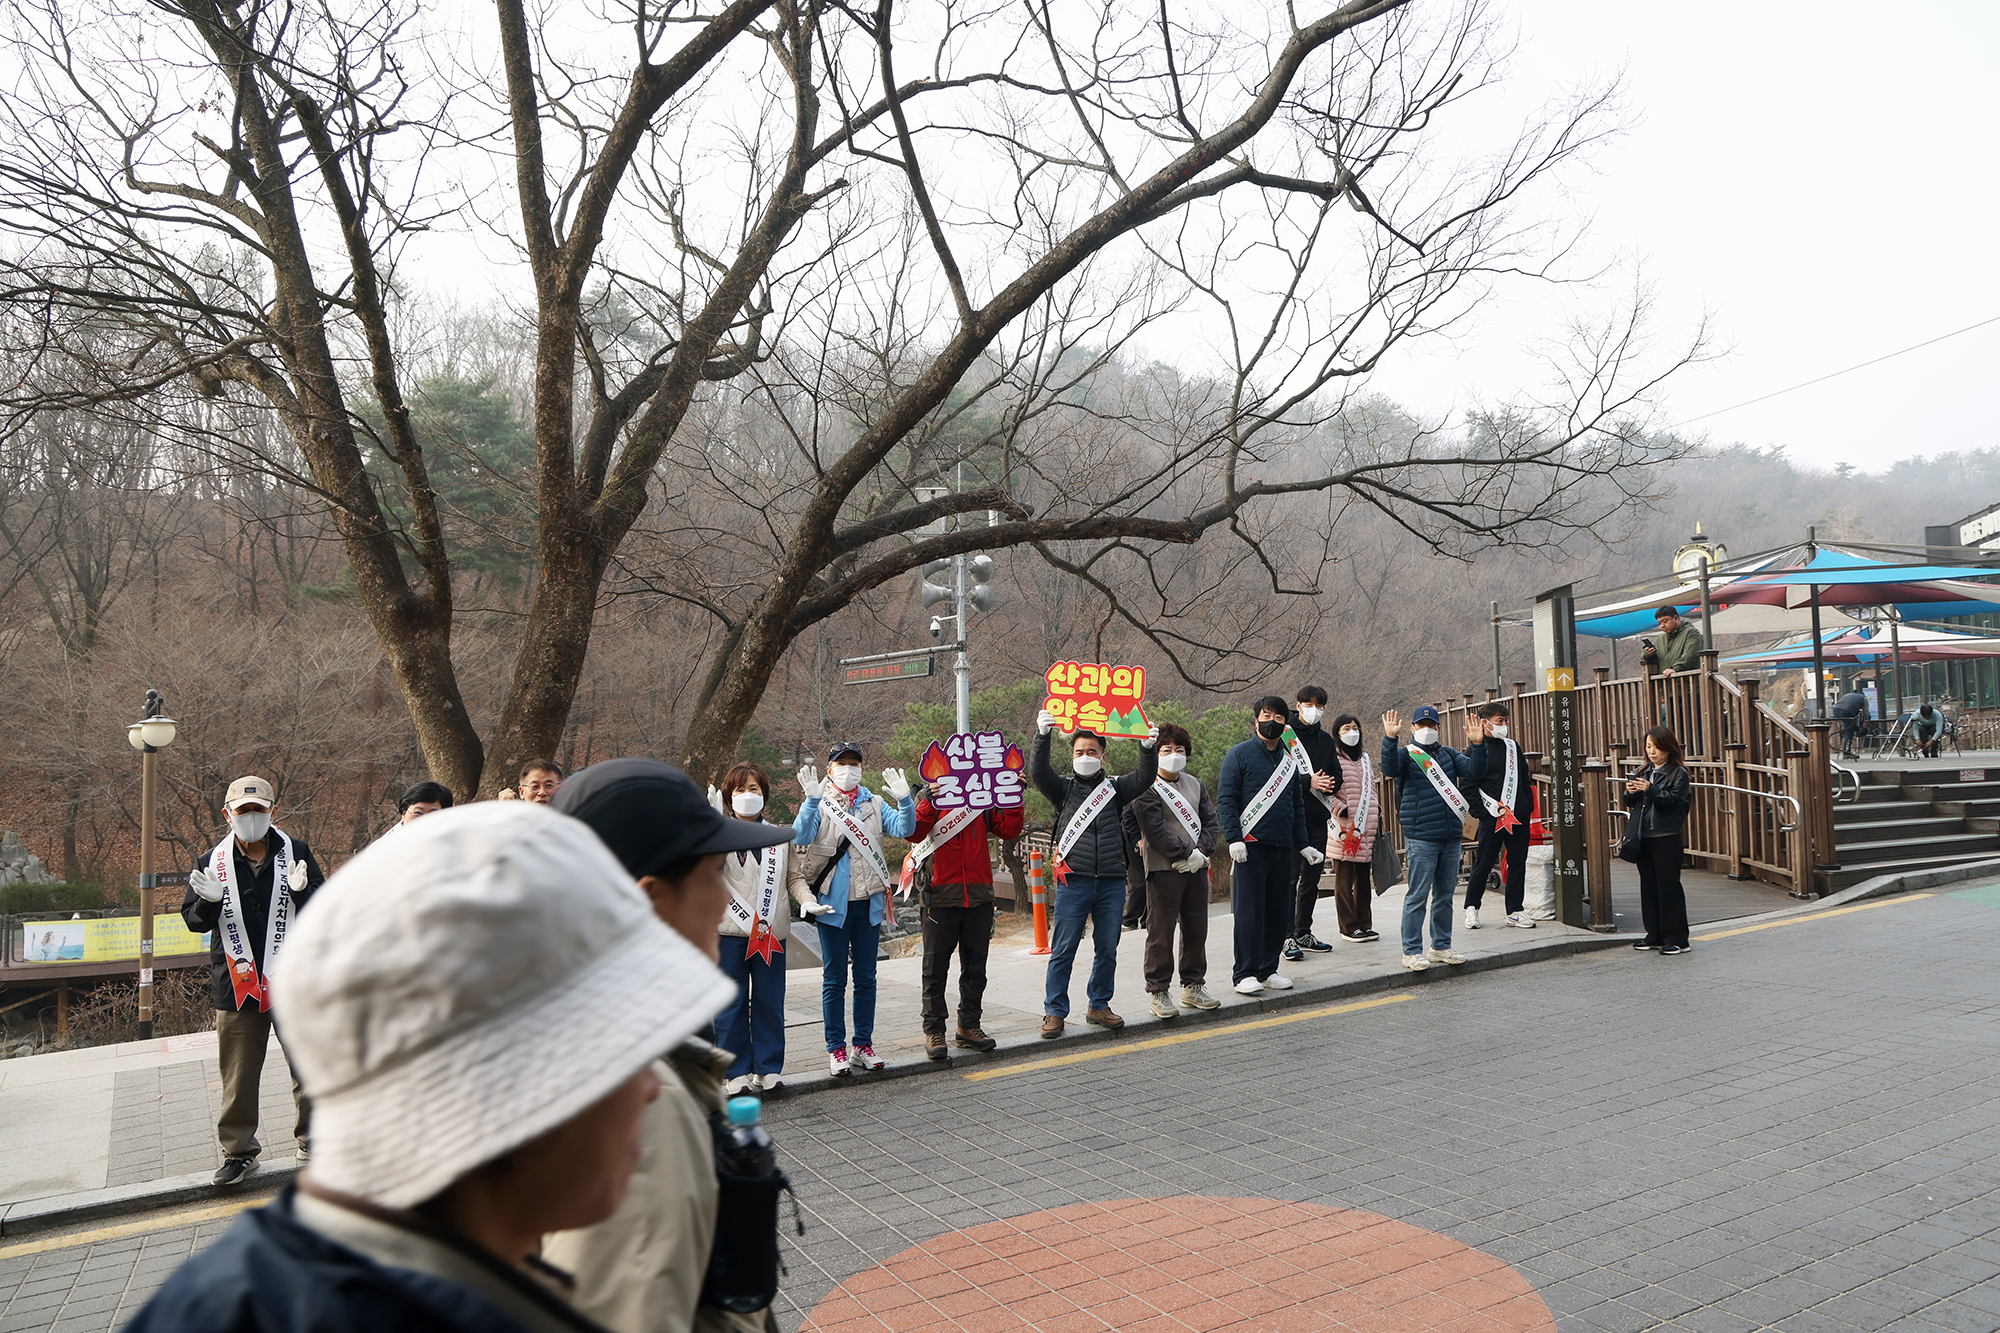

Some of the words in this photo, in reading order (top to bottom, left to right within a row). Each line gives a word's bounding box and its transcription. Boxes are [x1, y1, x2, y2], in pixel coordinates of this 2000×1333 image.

[1048, 664, 1142, 699] 산과의
[1046, 699, 1108, 733] 약속
[1561, 697, 1572, 771] 유희경·이매창
[947, 734, 1005, 770] 산불
[936, 771, 1022, 806] 조심은
[1091, 788, 1109, 807] 한순간
[1444, 787, 1461, 807] 한순간
[1564, 775, 1575, 827] 시비(詩碑)
[1074, 807, 1093, 829] 복구는
[1174, 800, 1193, 822] 한순간
[766, 858, 777, 885] 복구는
[216, 851, 227, 883] 한순간
[226, 923, 244, 955] 한평생
[761, 888, 773, 917] 한평생
